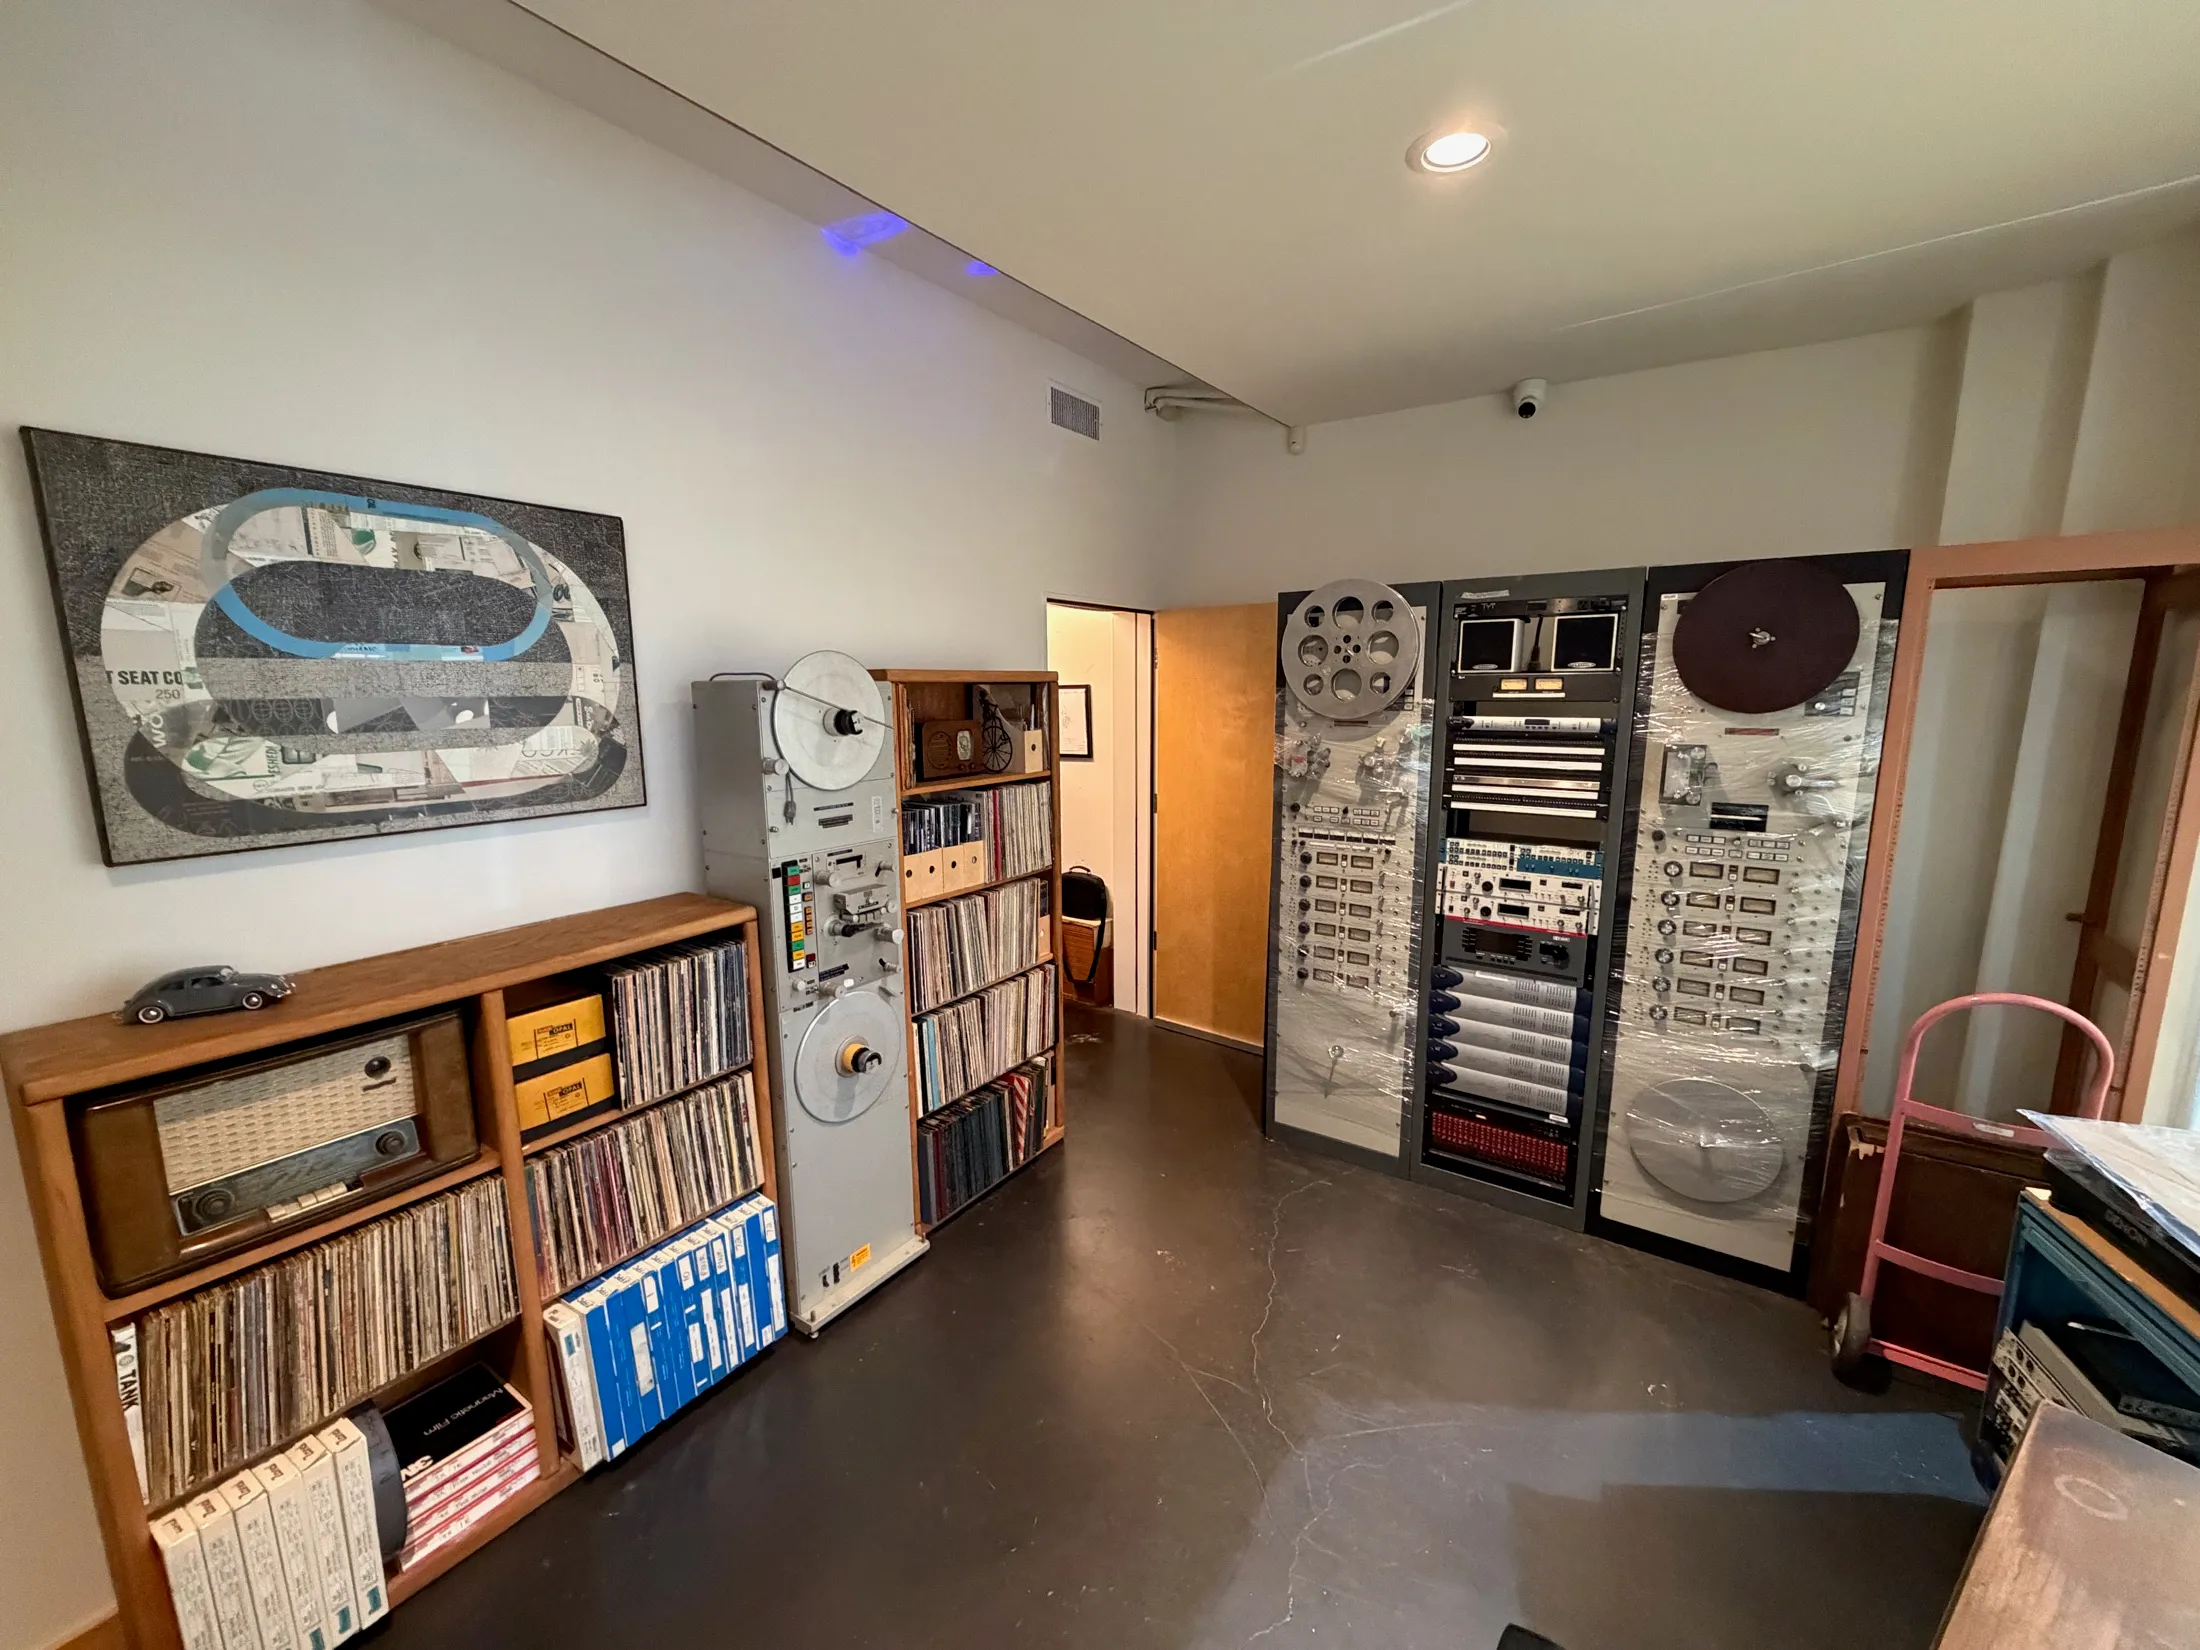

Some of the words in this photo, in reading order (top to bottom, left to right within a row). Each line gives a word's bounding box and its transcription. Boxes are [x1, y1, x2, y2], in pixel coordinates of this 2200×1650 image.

[118, 670, 159, 686] SEAT
[156, 689, 181, 700] 250
[2104, 1209, 2149, 1248] DENON
[120, 1369, 139, 1411] TANK
[450, 1387, 503, 1420] Magnetic
[423, 1418, 451, 1436] Film
